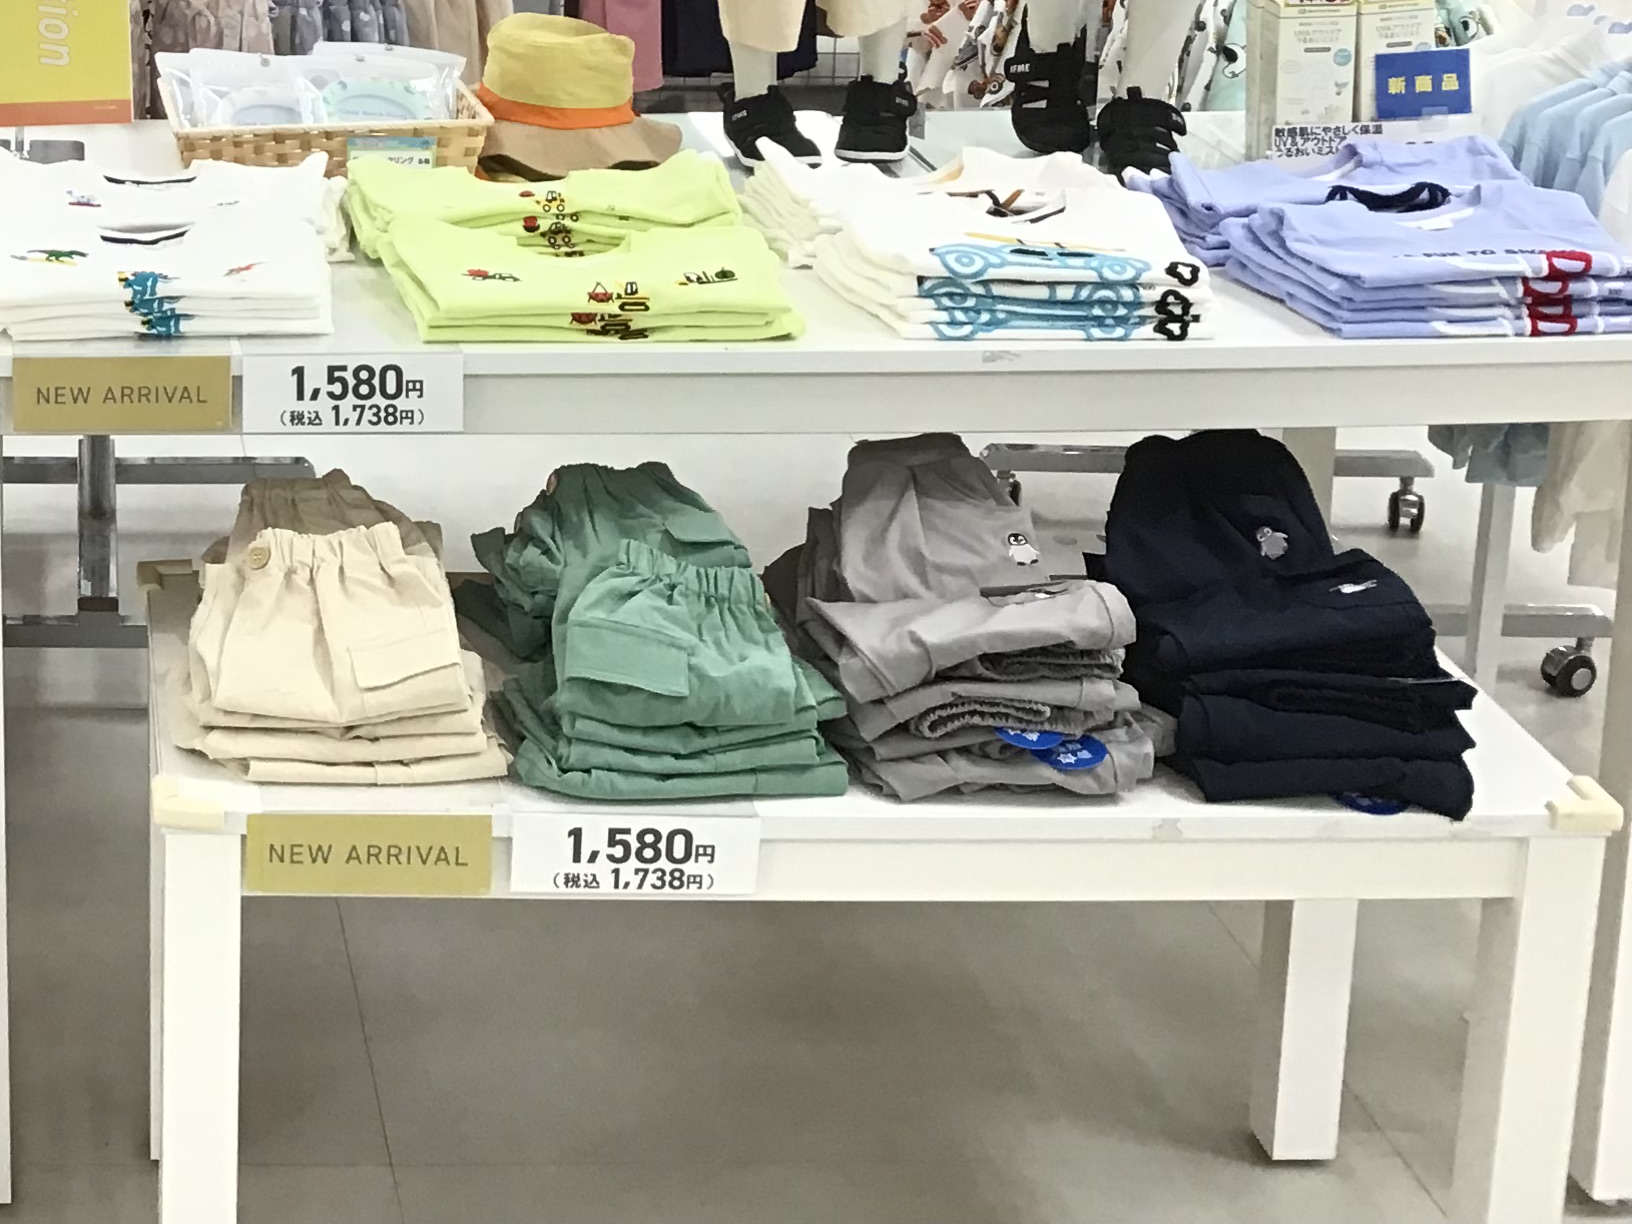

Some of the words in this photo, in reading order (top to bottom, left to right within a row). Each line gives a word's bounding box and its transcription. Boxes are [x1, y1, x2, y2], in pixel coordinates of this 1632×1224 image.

[36, 387, 92, 405] NEW
[102, 385, 208, 405] ARRIVAL
[290, 364, 424, 402] 1,580円
[268, 844, 332, 865] NEW
[345, 843, 469, 868] ARRIVAL
[567, 827, 716, 865] 1,580円
